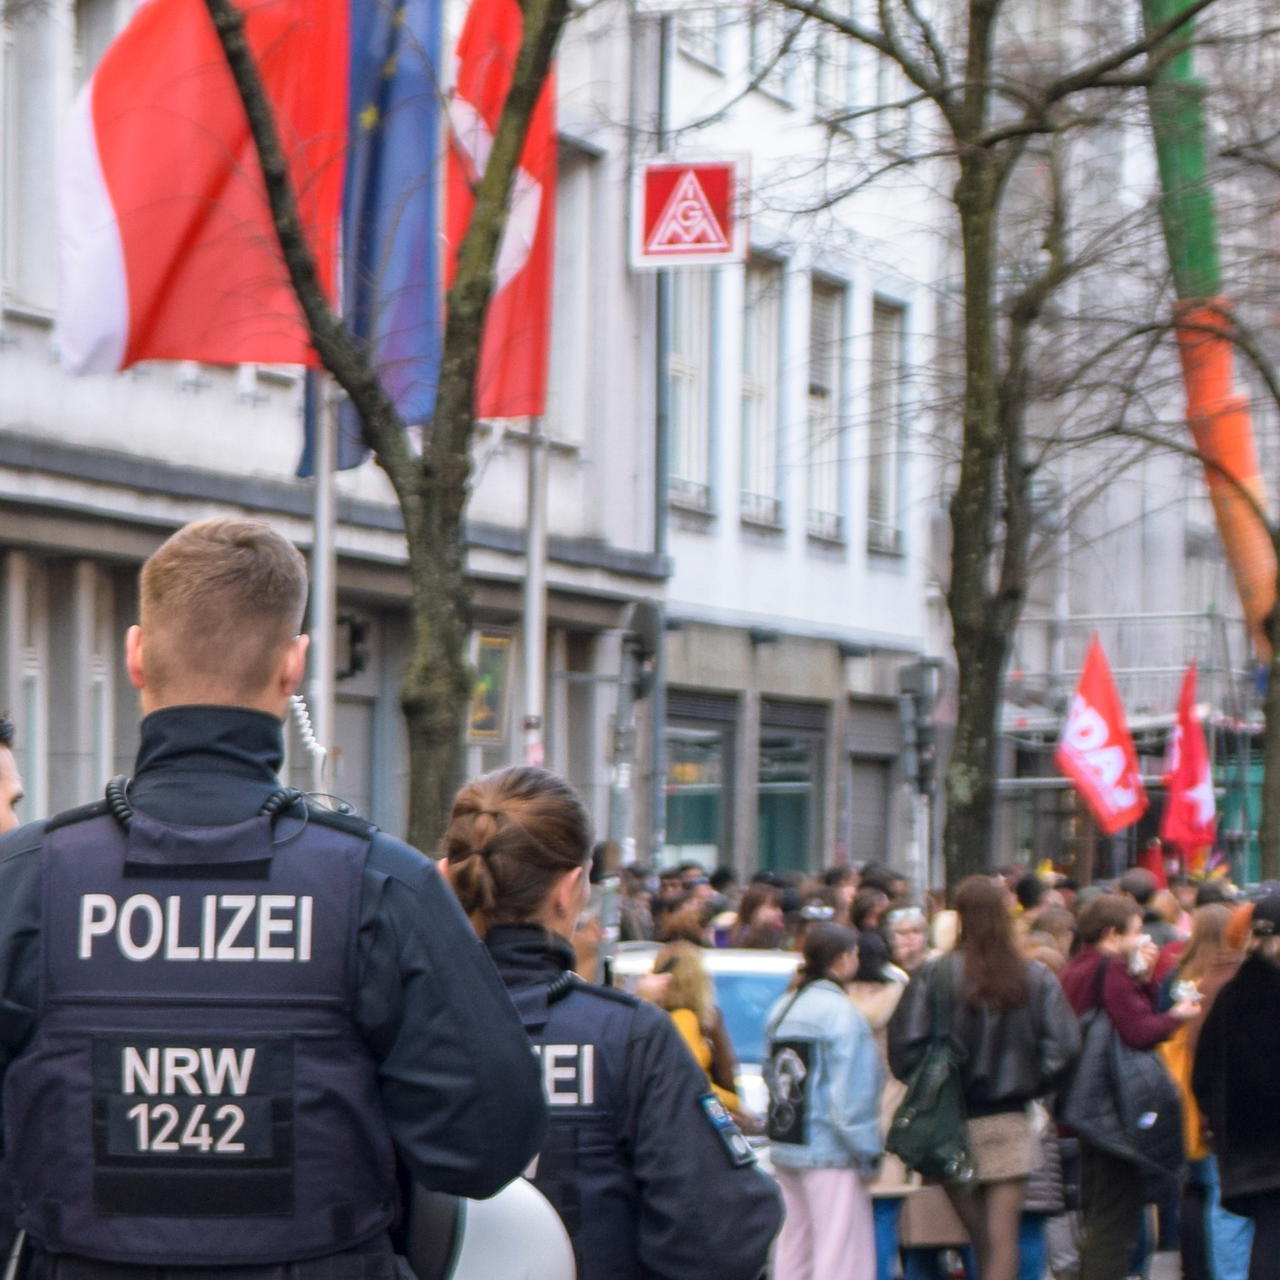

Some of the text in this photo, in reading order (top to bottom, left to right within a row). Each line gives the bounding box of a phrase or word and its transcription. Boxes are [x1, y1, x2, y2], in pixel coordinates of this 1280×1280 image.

[77, 892, 314, 963] POLIZEI
[121, 1045, 257, 1097] NRW
[533, 1044, 594, 1105] EI
[127, 1102, 246, 1153] 1242
